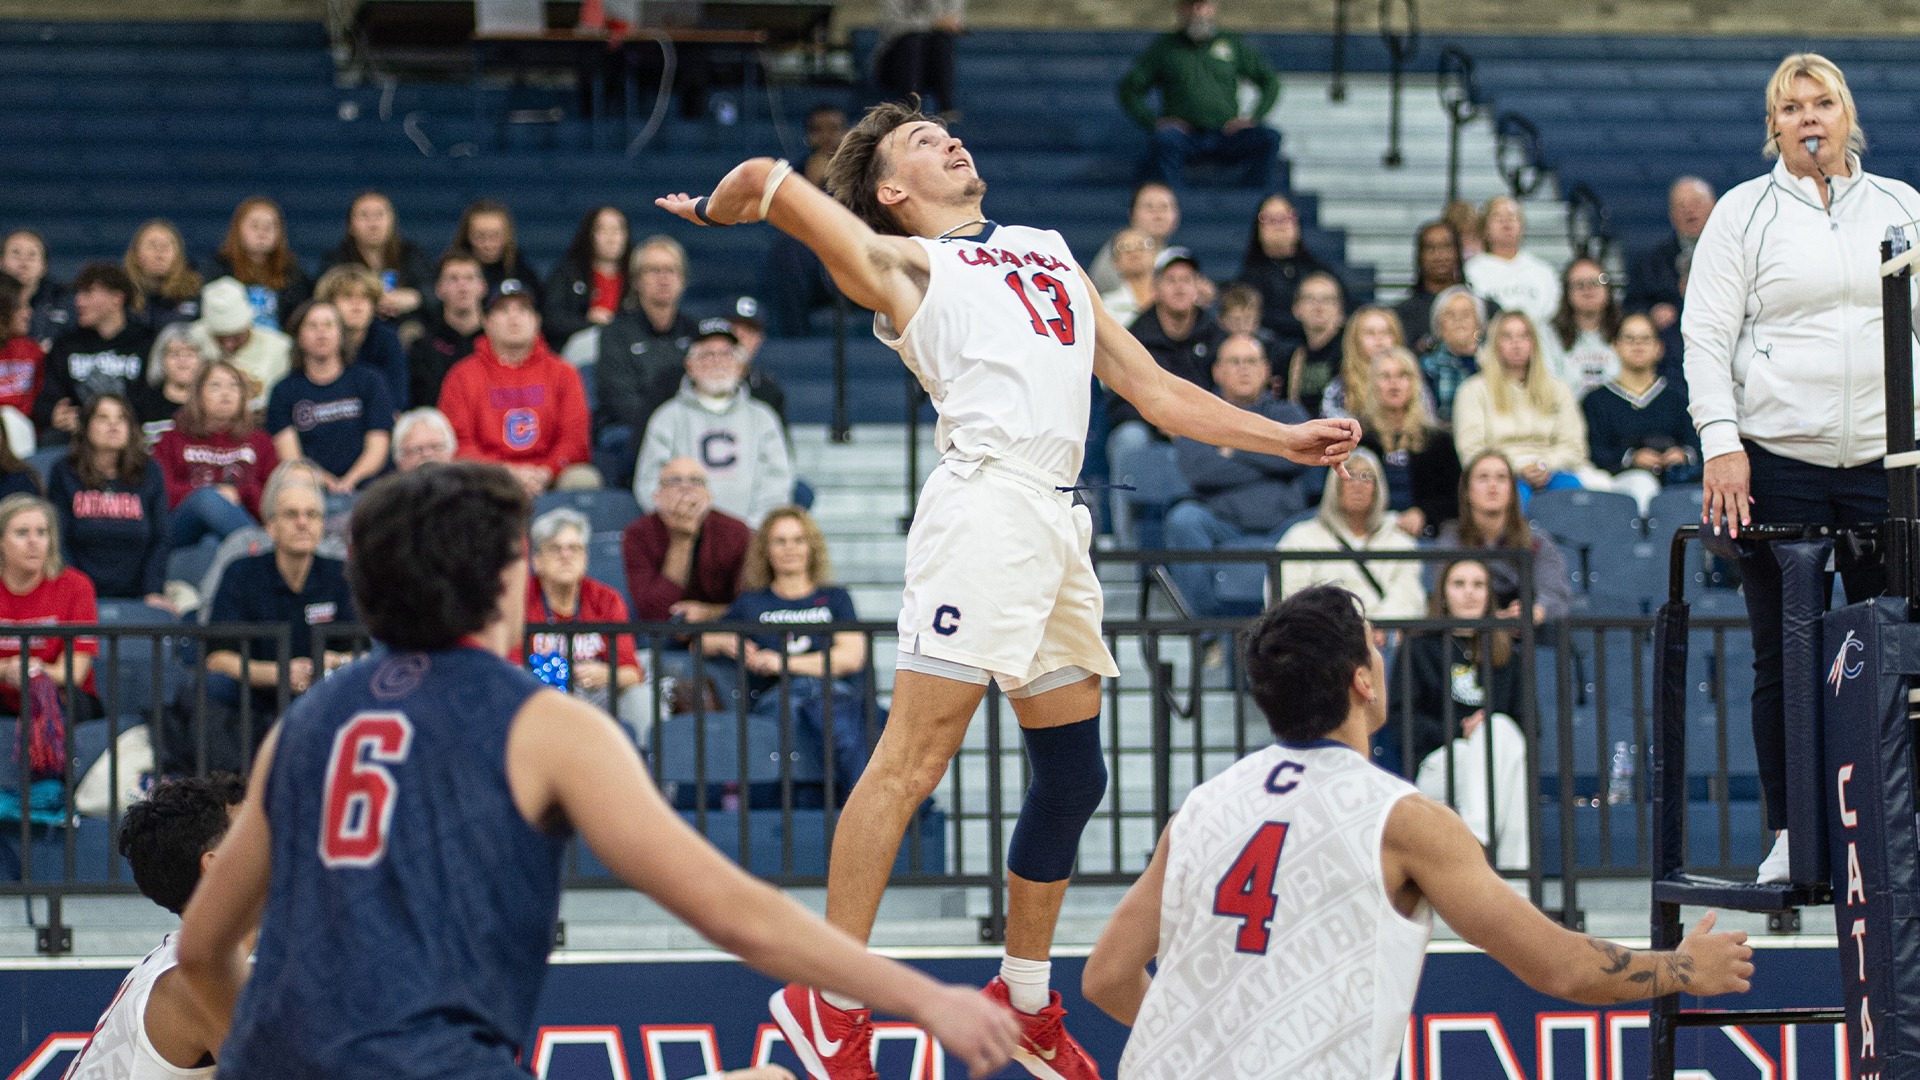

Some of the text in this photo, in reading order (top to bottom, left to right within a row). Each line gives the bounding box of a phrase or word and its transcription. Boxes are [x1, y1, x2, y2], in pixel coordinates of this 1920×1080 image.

[1004, 270, 1075, 345] 13
[699, 431, 737, 469] C
[932, 604, 961, 636] C
[318, 711, 415, 868] 6
[1264, 759, 1307, 795] C
[1212, 820, 1290, 956] 4
[1837, 763, 1880, 1080] CATA
